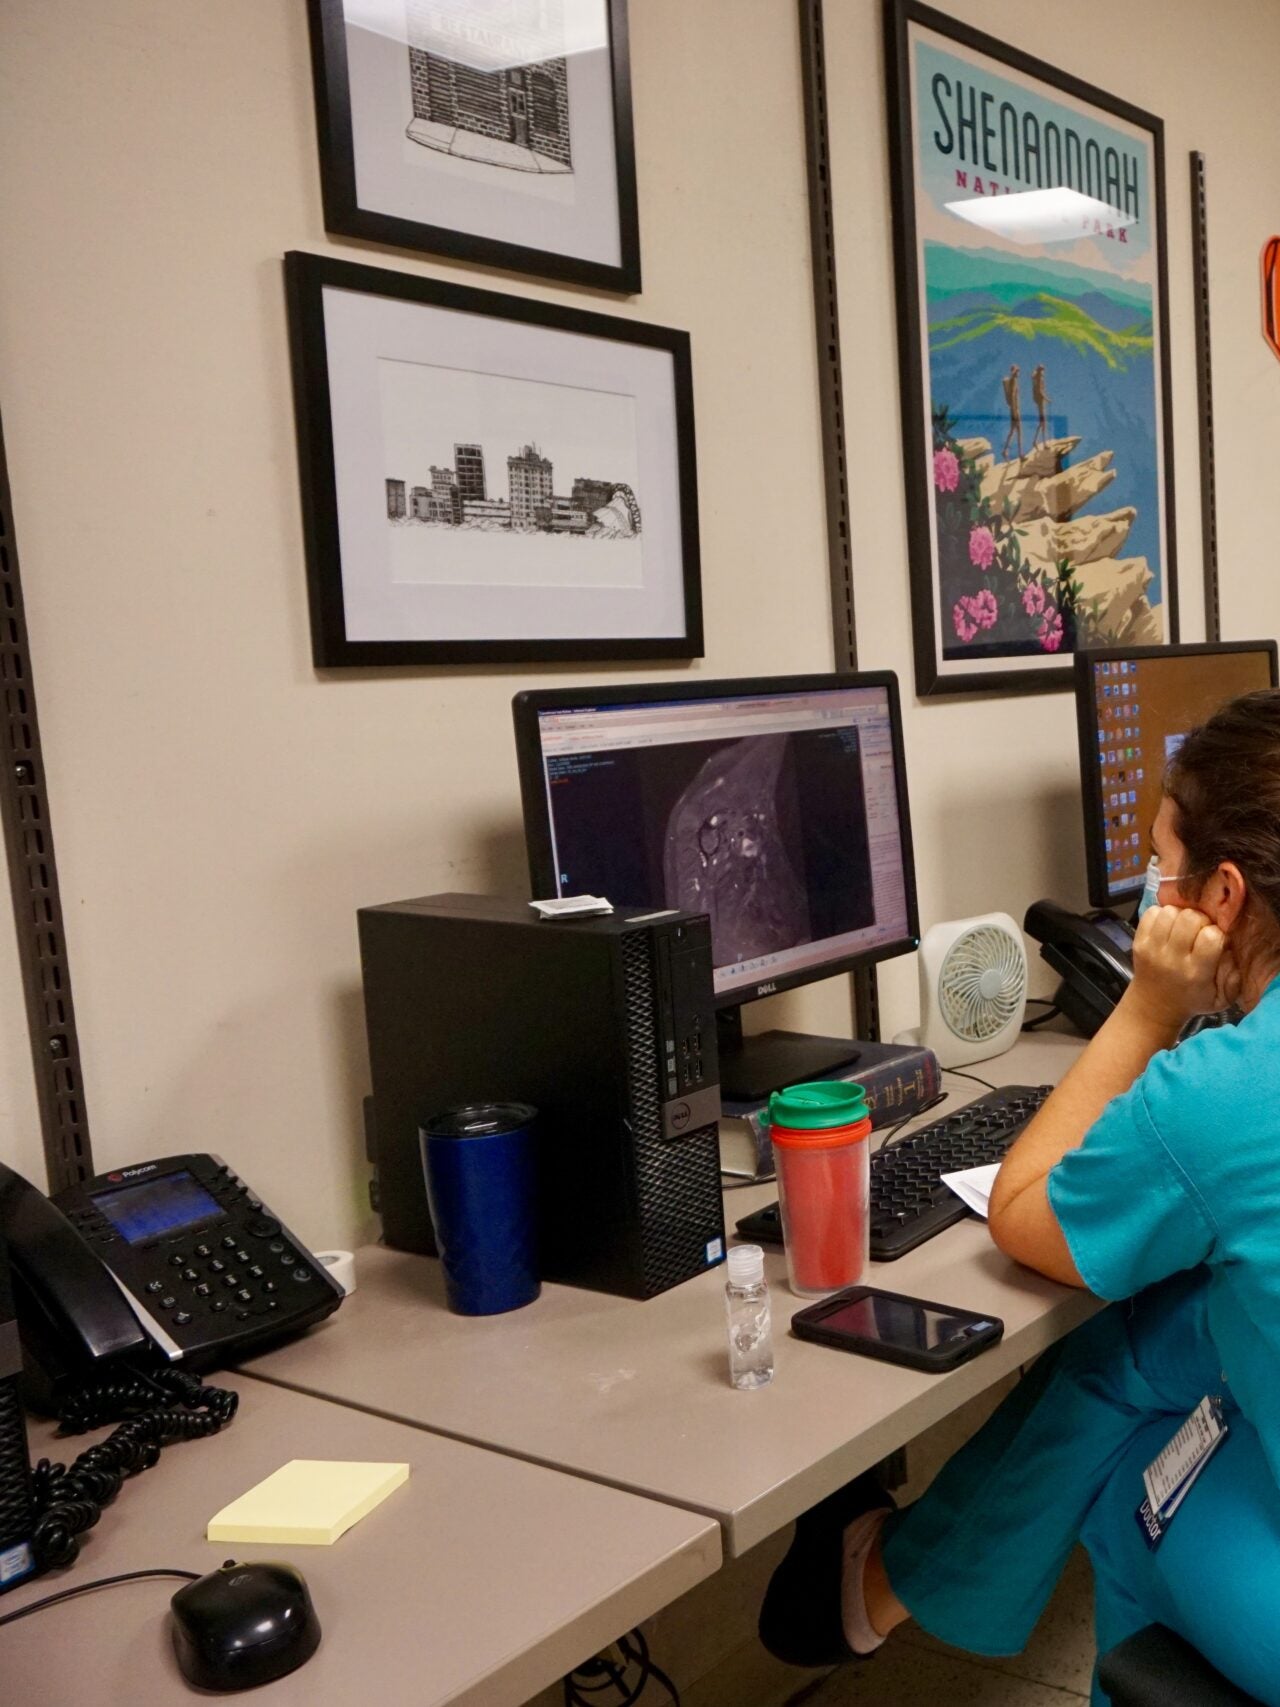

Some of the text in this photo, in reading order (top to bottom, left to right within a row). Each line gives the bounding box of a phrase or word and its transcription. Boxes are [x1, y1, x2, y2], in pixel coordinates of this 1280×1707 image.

[931, 72, 1139, 224] SHENANDOAH
[560, 873, 568, 884] R
[757, 982, 777, 996] DELL
[122, 1163, 157, 1178] Polycom
